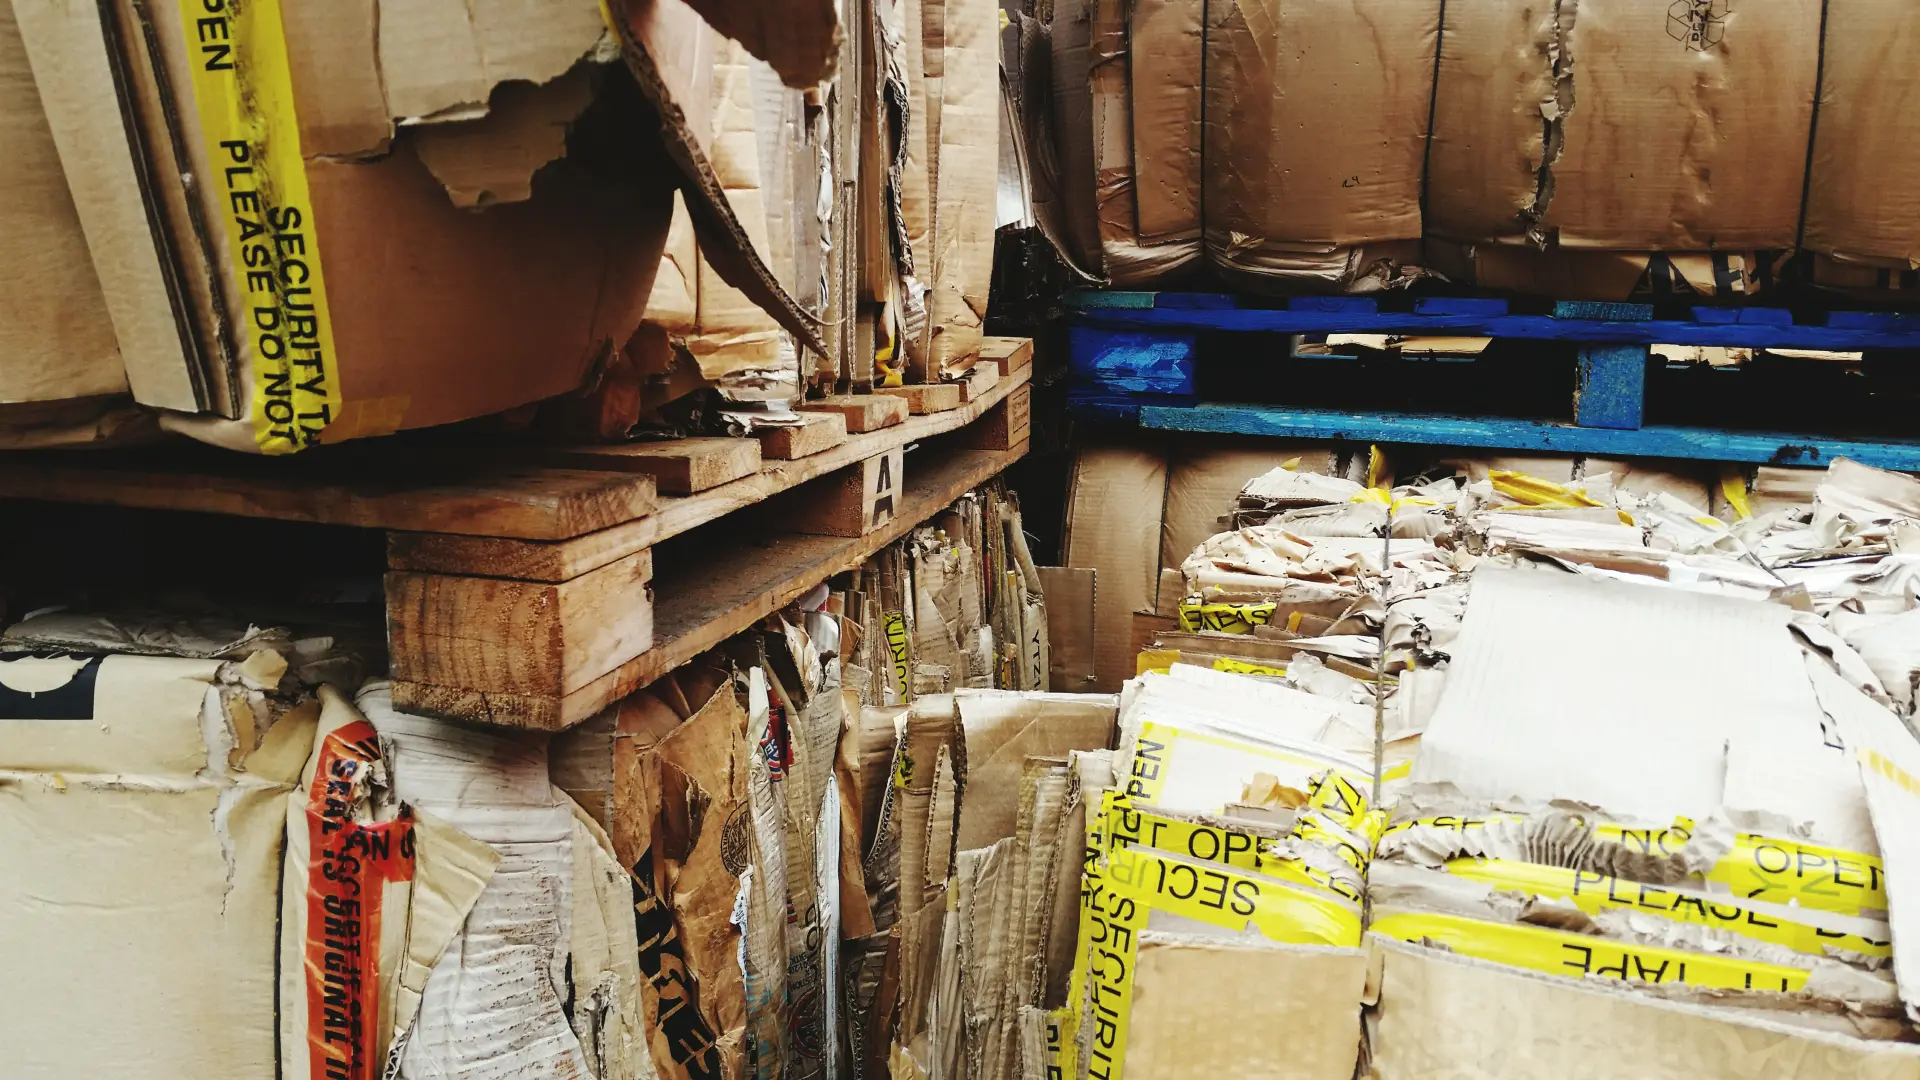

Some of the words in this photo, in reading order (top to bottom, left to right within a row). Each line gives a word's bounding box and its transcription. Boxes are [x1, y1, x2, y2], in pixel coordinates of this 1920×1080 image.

[220, 140, 275, 293] PLEASE
[253, 307, 285, 360] DO
[267, 206, 327, 397] SECURITY
[263, 373, 298, 446] NOT
[322, 758, 358, 835] SEAL
[1126, 739, 1165, 799] PEN
[323, 894, 350, 1044] ORIGINAL
